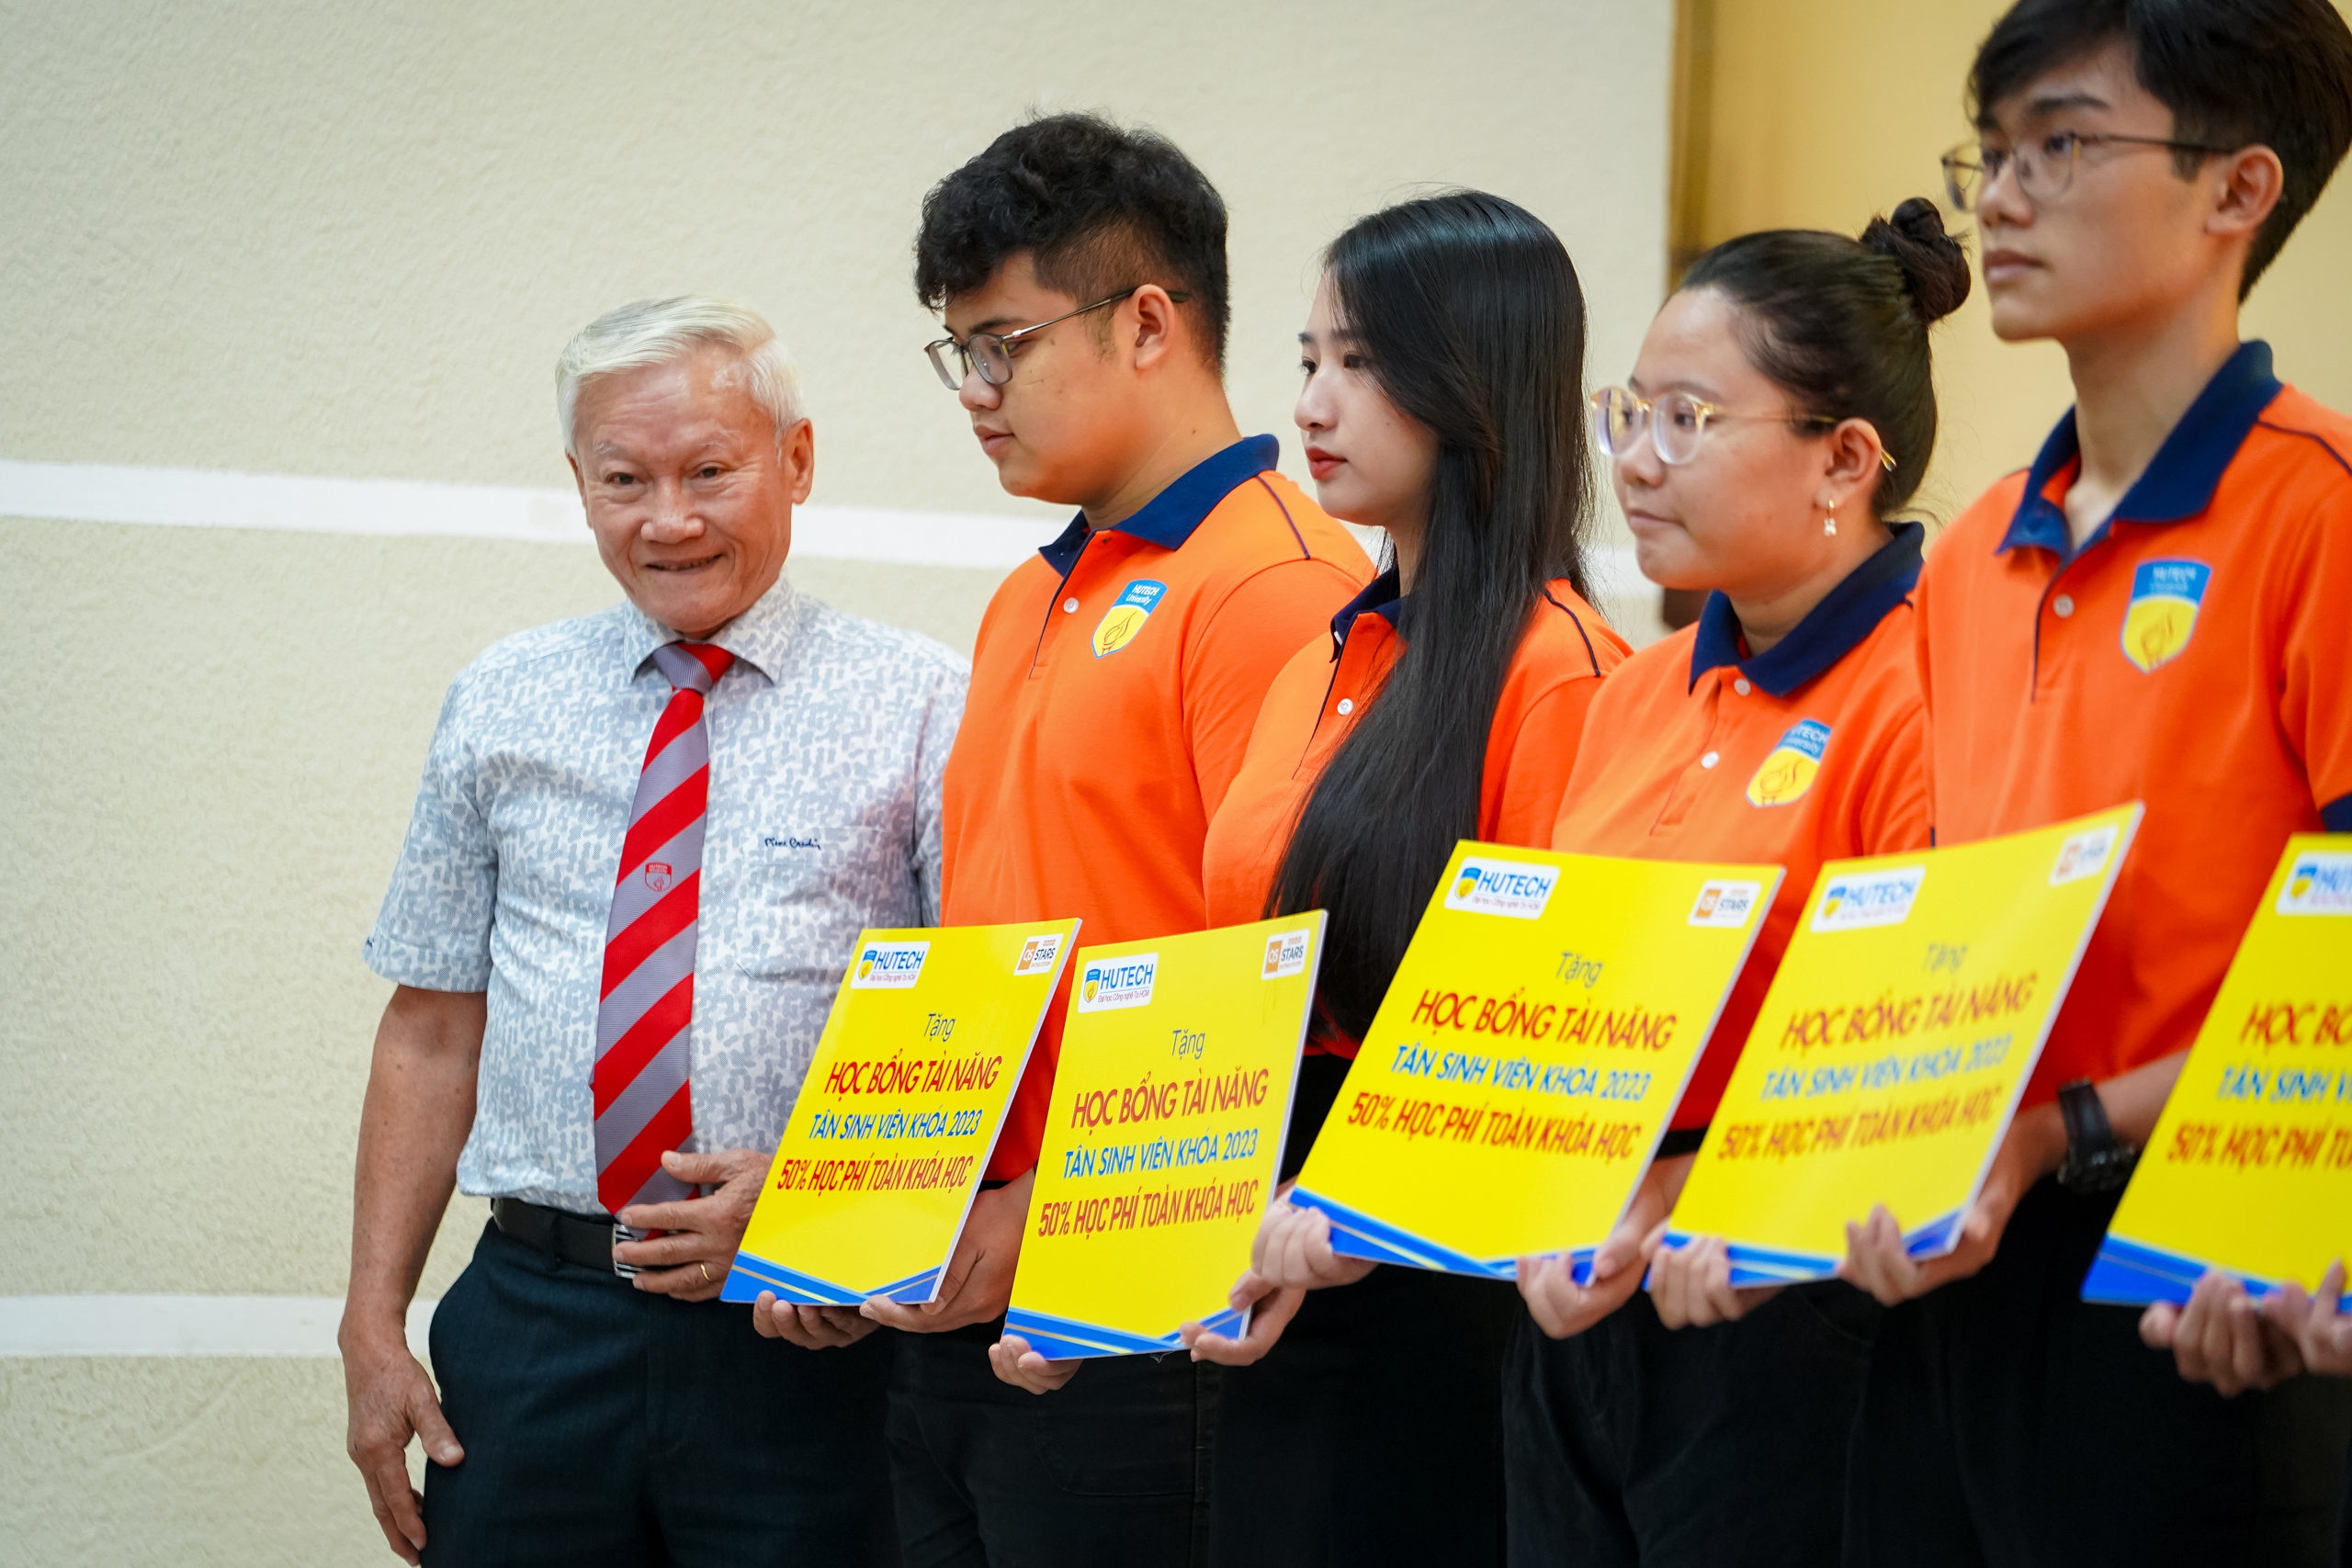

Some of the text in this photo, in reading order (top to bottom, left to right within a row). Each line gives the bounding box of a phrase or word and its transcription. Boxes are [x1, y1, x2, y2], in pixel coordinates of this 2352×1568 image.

[1125, 592, 1152, 606] University
[1131, 583, 1160, 596] HUTECH
[1477, 871, 1552, 898] HUTECH
[874, 951, 925, 970] HUTECH
[1023, 947, 1056, 963] QS STARS
[1268, 945, 1304, 964] QS STARS
[1555, 950, 1604, 989] Tặng
[1101, 964, 1154, 990] HUTECH
[923, 1013, 956, 1043] Tặng
[1412, 987, 1678, 1052] HỌC BỔNG TÀI NĂNG
[1172, 1029, 1205, 1060] Tặng
[824, 1049, 1002, 1101] HỌC BỔNG TÀI NĂNG
[1392, 1043, 1652, 1101] TÂN SINH VIÊN KHÓA 2023
[1071, 1066, 1269, 1136] HỌC BỔNG TÀI NĂNG
[809, 1105, 982, 1139] TÂN SINH VIÊN KHÓA 2023
[1347, 1091, 1642, 1165] 50% HỌC PHÍ TOÀN KHÓA HỌC
[1064, 1128, 1258, 1179] TÂN SINH VIÊN KHÓA 2023
[777, 1150, 974, 1197] 50% HỌC PHÍ TOÀN KHÓA HỌC
[1038, 1178, 1259, 1240] 50% HỌC PHÍ TOÀN KHÓA HỌC
